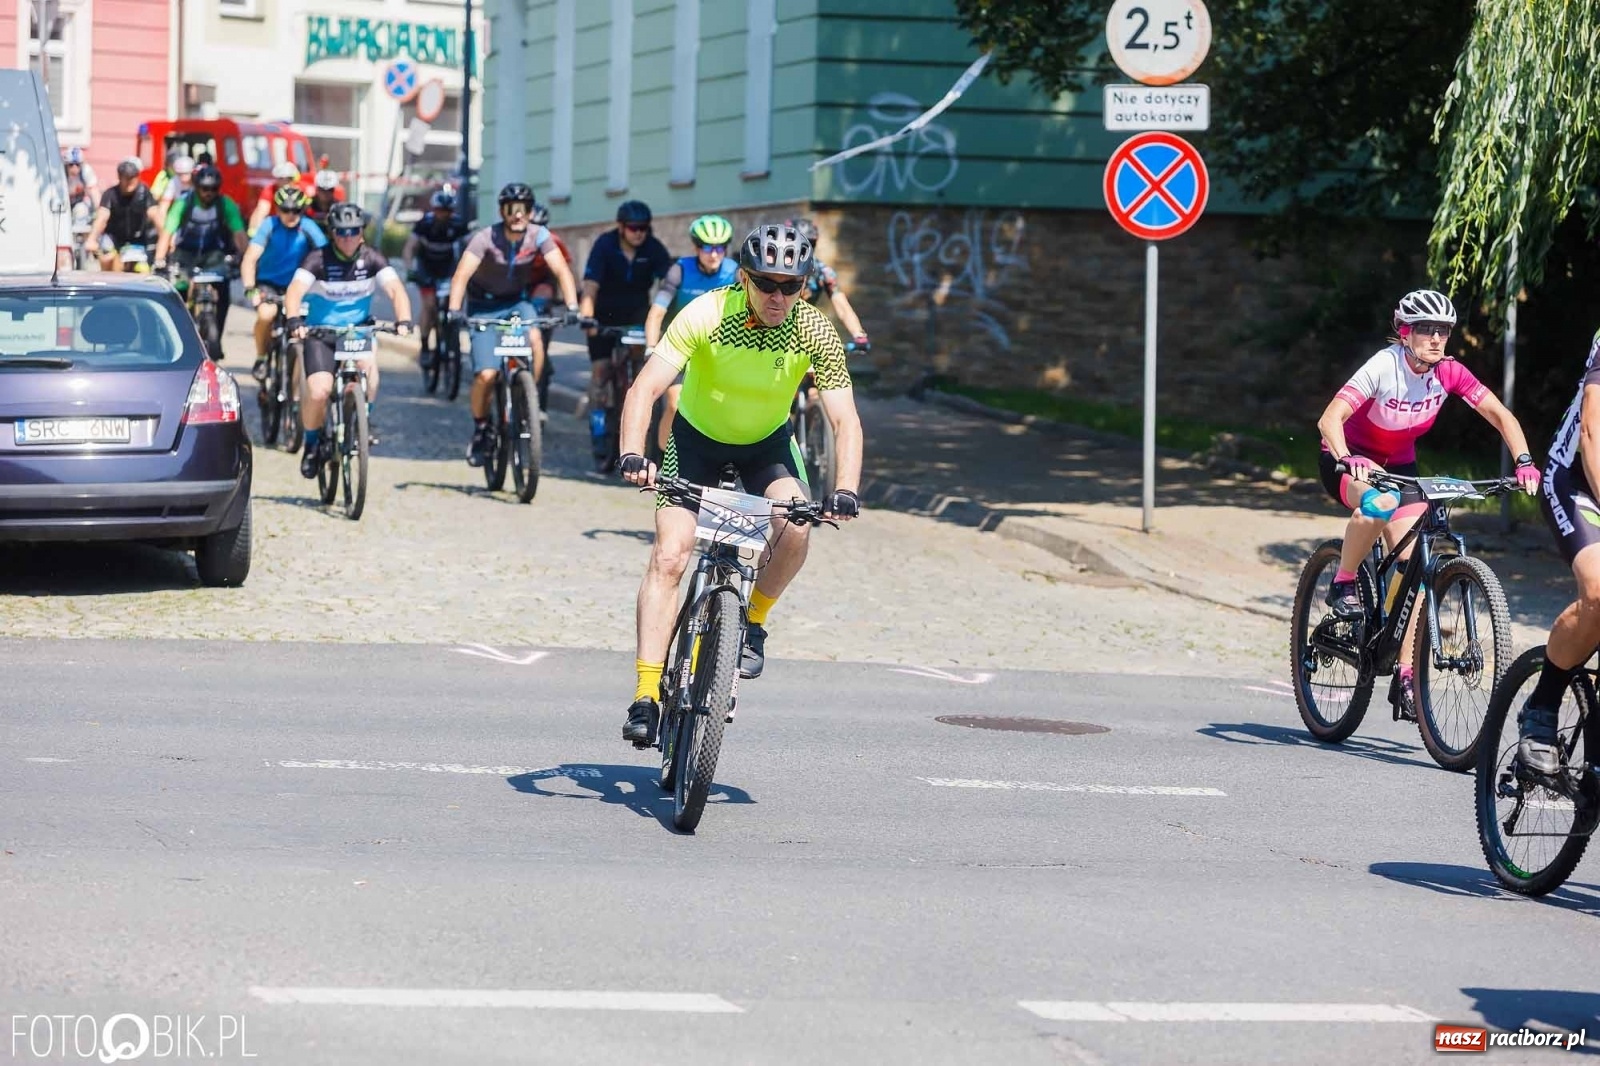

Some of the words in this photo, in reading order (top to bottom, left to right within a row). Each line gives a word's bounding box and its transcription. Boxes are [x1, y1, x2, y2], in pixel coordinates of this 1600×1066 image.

[1114, 92, 1138, 105] Nie
[1144, 92, 1201, 108] dotyczy
[1385, 394, 1443, 413] SCOTT
[1431, 483, 1469, 493] 1444
[1393, 586, 1416, 641] SCOTT
